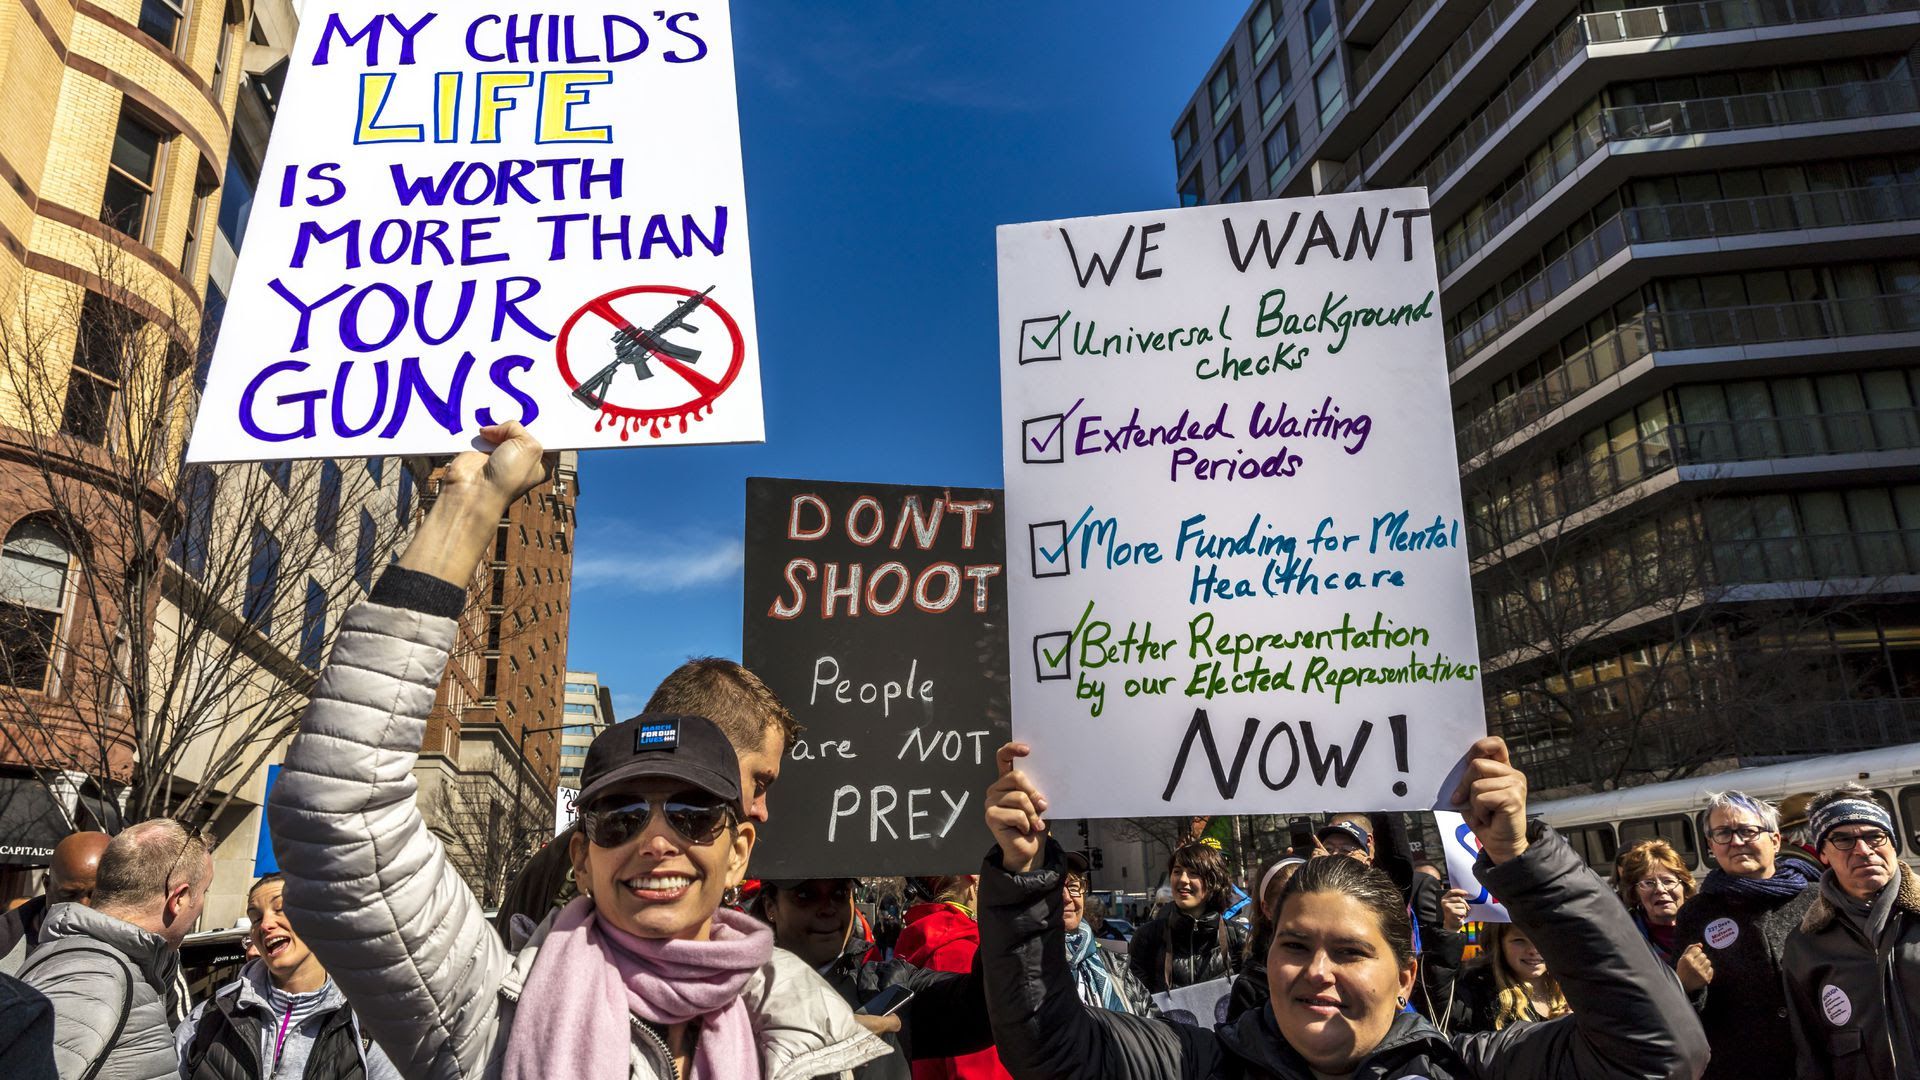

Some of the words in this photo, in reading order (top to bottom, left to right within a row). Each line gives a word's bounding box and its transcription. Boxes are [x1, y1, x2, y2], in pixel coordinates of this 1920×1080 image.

[312, 13, 438, 67] MY
[466, 11, 707, 63] CHILD'S
[353, 70, 613, 145] LIFE
[280, 163, 346, 207] IS
[390, 158, 624, 207] WORTH
[289, 217, 510, 269] MORE
[538, 206, 728, 261] THAN
[1059, 222, 1166, 288] WE
[1222, 206, 1431, 273] WANT
[268, 276, 557, 353] YOUR
[1074, 305, 1232, 357] Universal
[239, 351, 540, 442] GUNS
[1075, 403, 1235, 457] Extended
[1249, 396, 1373, 455] Waiting
[1171, 446, 1304, 483] Periods
[788, 490, 994, 550] DON'T
[1081, 517, 1163, 570] More
[1175, 513, 1298, 576] Funding
[1307, 516, 1360, 555] for
[1369, 510, 1459, 555] Mental
[768, 557, 1001, 619] SHOOT
[1190, 557, 1406, 605] Healthcare
[1079, 621, 1178, 669] Better
[1189, 611, 1430, 672] Representation
[810, 656, 935, 718] People
[1076, 671, 1106, 718] by
[1125, 676, 1177, 698] our
[1184, 660, 1296, 700] Elected
[1302, 651, 1479, 704] Representatives
[640, 736, 664, 744] LIVES
[641, 724, 672, 732] MARCH
[791, 738, 858, 761] are
[898, 727, 990, 765] NOT
[1162, 707, 1410, 802] NOW!
[828, 784, 970, 843] PREY
[0, 845, 45, 857] CAPITAL
